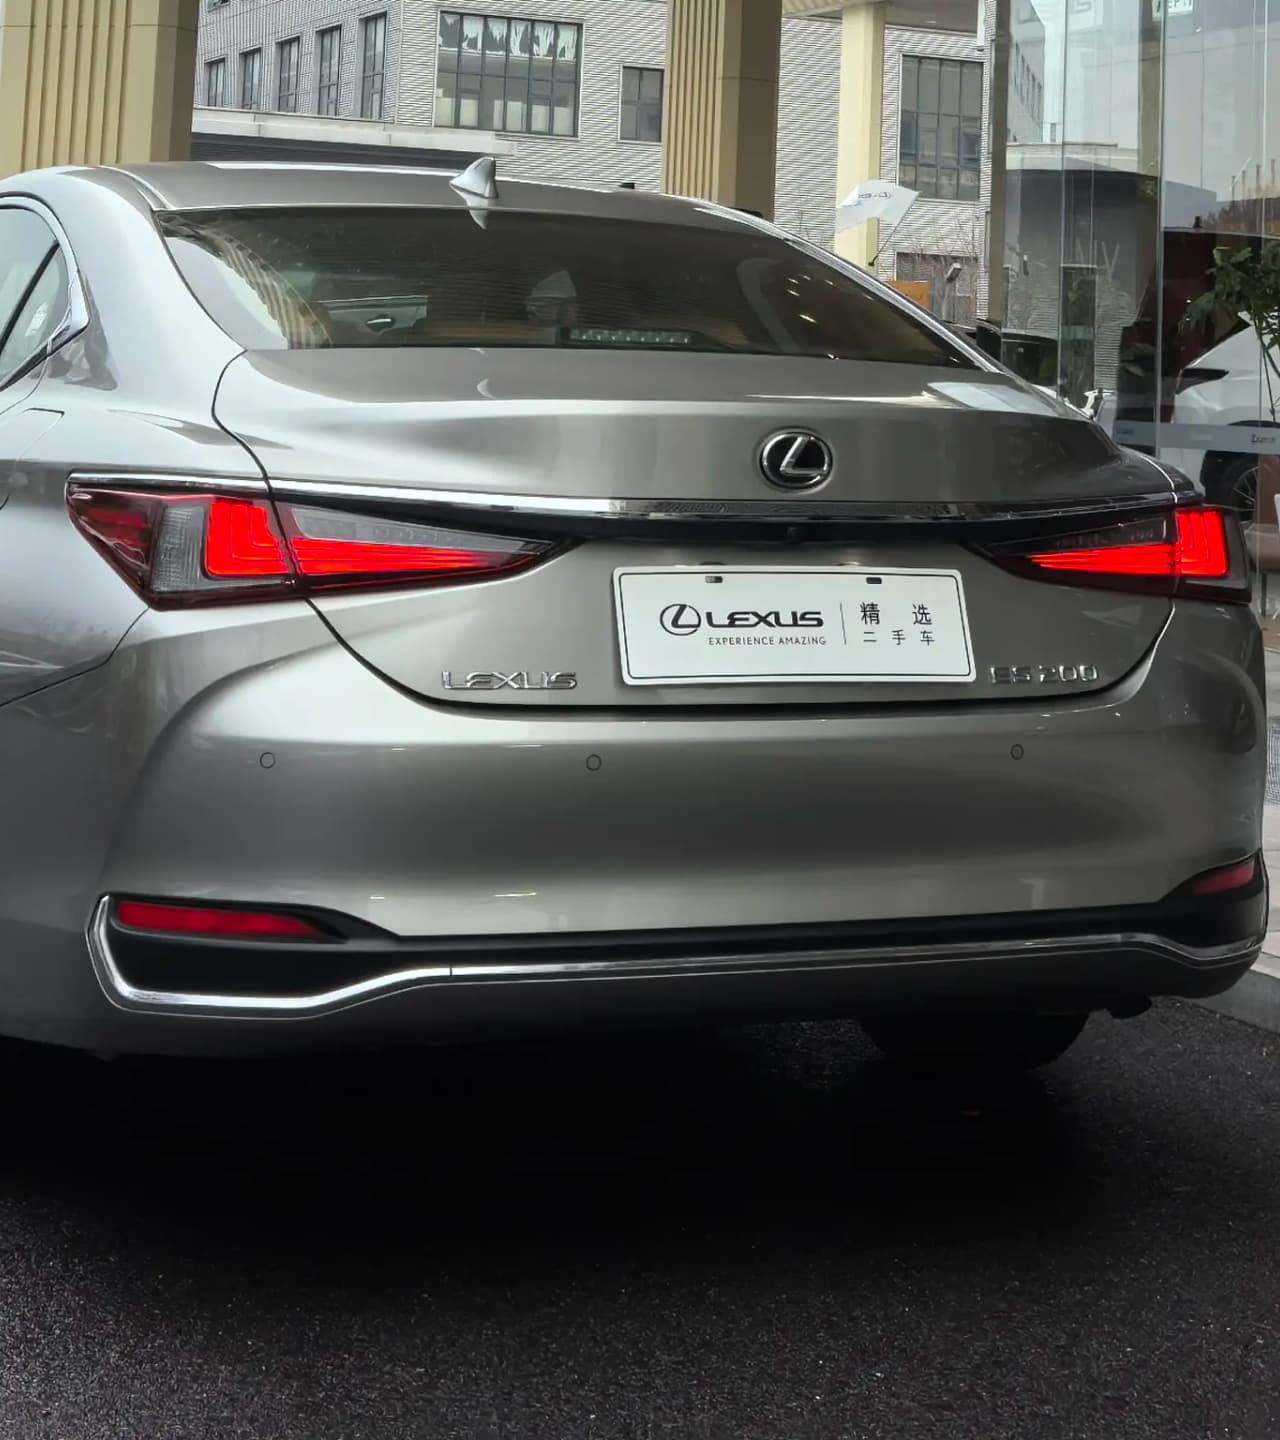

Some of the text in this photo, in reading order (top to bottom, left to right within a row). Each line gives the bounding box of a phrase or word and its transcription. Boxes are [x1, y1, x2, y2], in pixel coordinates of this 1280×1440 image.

[706, 609, 824, 628] LEXUS
[708, 635, 827, 647] EXPERIENCE AMAZING
[441, 670, 578, 691] LEXUS
[989, 664, 1099, 685] ES 200
